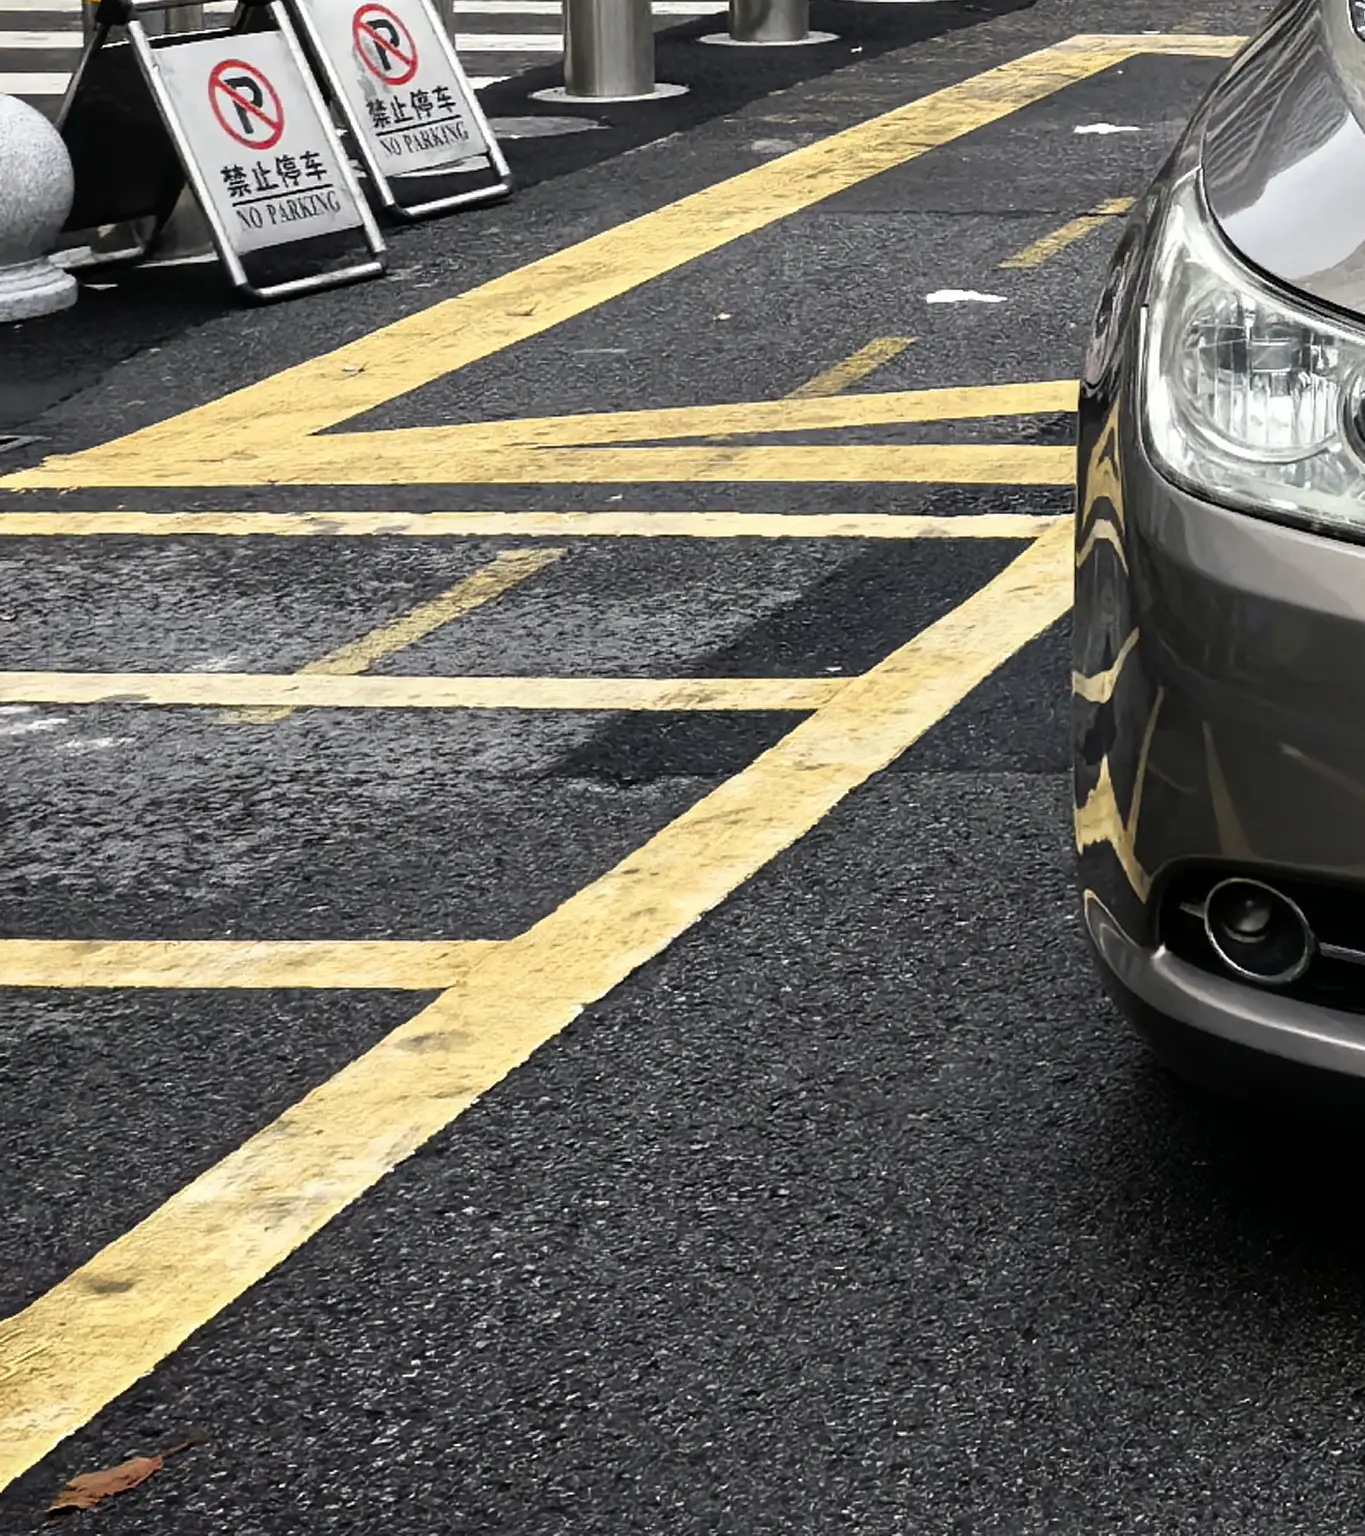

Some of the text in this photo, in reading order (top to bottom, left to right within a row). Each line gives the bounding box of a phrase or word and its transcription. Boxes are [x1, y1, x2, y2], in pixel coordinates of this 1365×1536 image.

[365, 85, 457, 128] 禁止停车
[379, 120, 470, 156] NO PARKING
[220, 150, 328, 198] 禁止停车
[235, 190, 341, 232] NO PARKING
